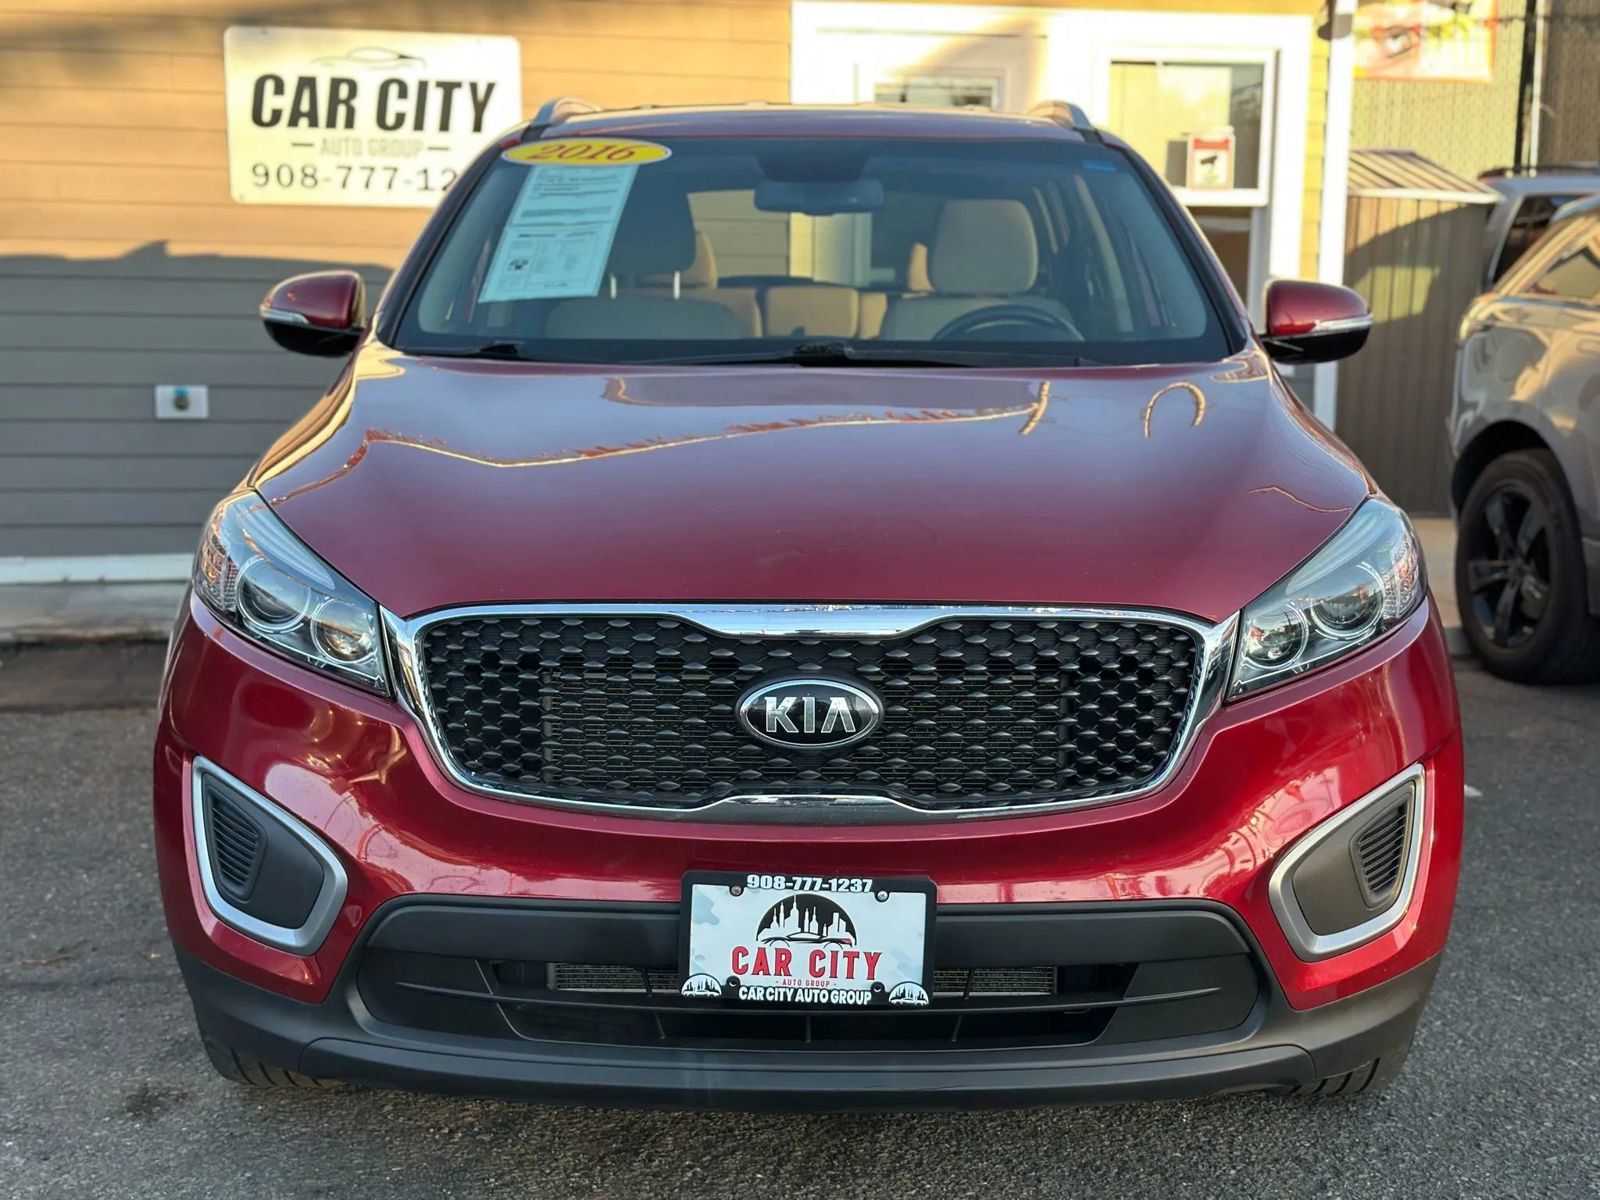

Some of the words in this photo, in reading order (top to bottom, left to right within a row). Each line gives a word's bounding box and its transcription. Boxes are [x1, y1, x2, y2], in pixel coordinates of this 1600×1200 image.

[251, 74, 358, 129] CAR
[375, 78, 496, 133] CITY
[320, 137, 362, 156] AUTO
[368, 138, 424, 158] GROUP
[527, 144, 644, 160] 2016
[252, 162, 458, 192] 908-777-12
[764, 696, 856, 733] KIA
[746, 875, 873, 892] 908-777-1237
[731, 945, 792, 976] CAR
[808, 949, 882, 980] CITY
[738, 987, 764, 1000] CAR
[765, 988, 794, 1002] CITY
[796, 988, 830, 1003] AUTO
[831, 989, 872, 1005] GROUP
